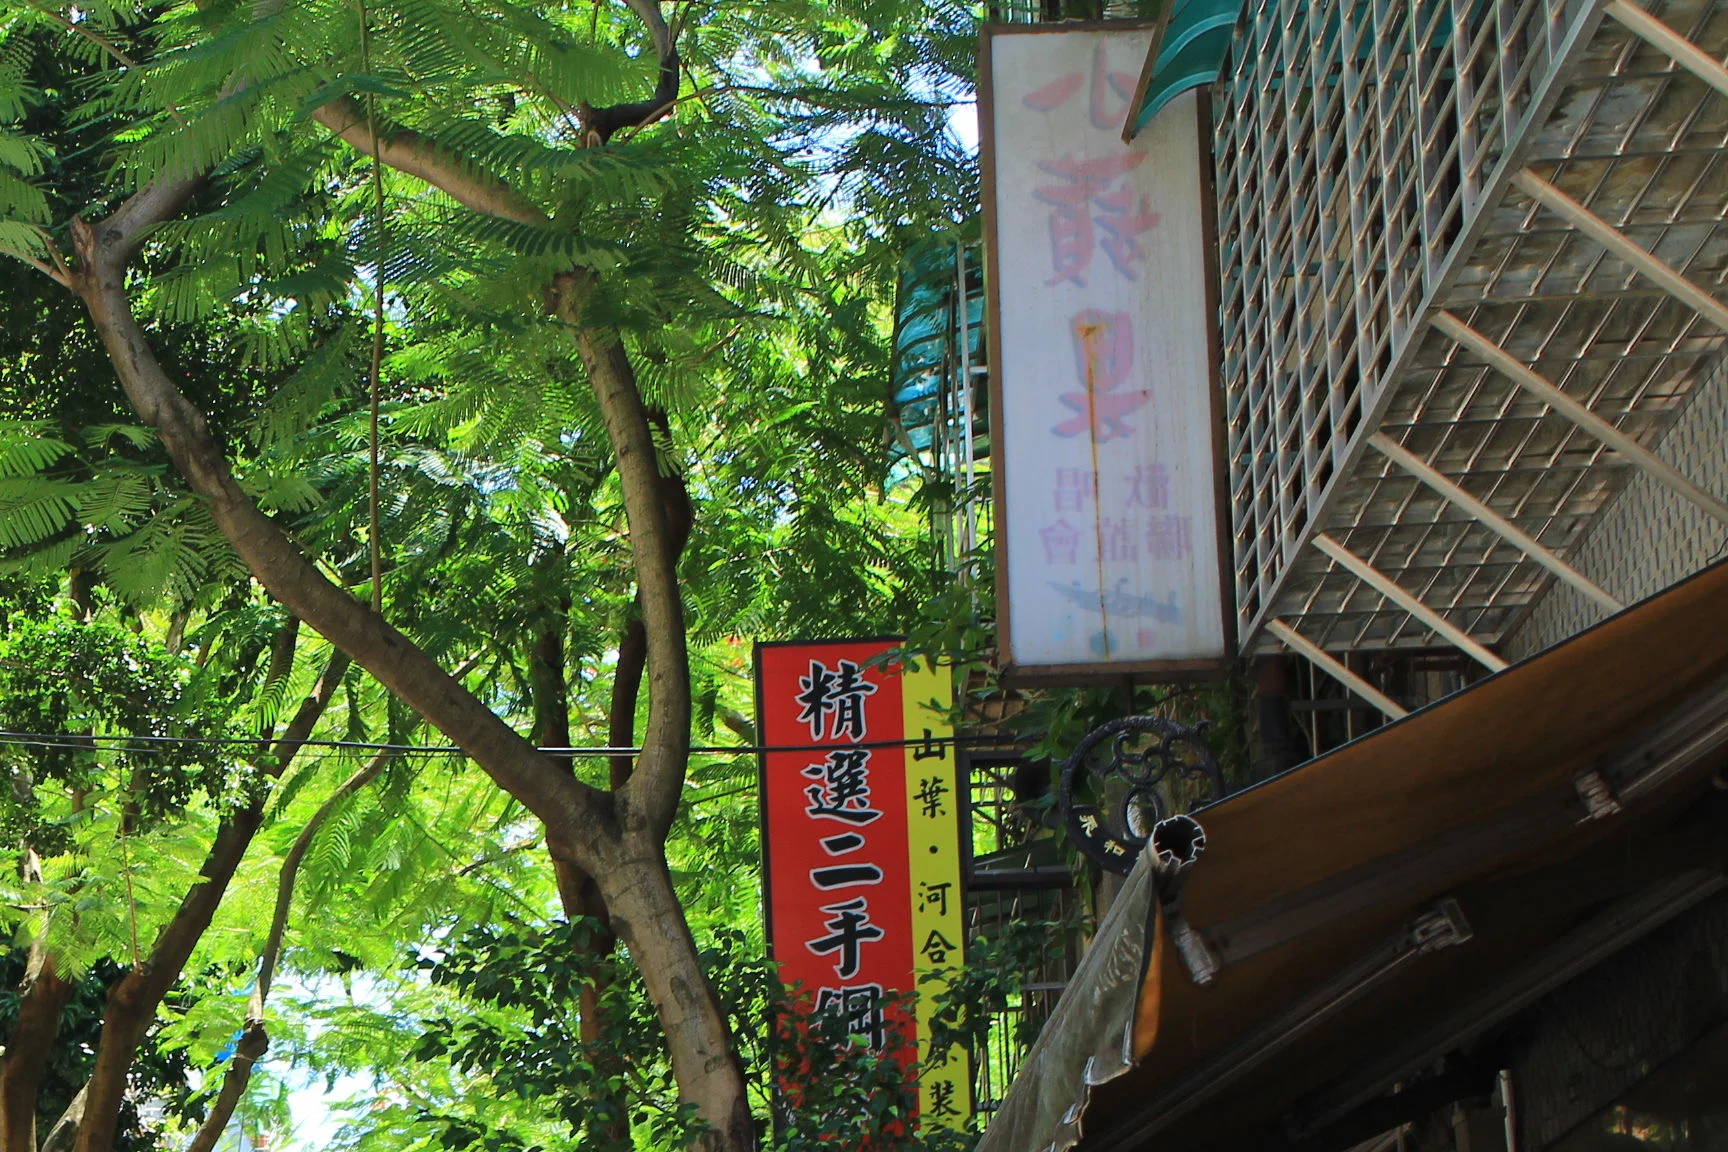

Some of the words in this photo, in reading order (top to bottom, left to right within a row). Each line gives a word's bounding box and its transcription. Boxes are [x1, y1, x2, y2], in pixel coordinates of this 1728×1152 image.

[795, 659, 886, 1135] 精選二手鋼
